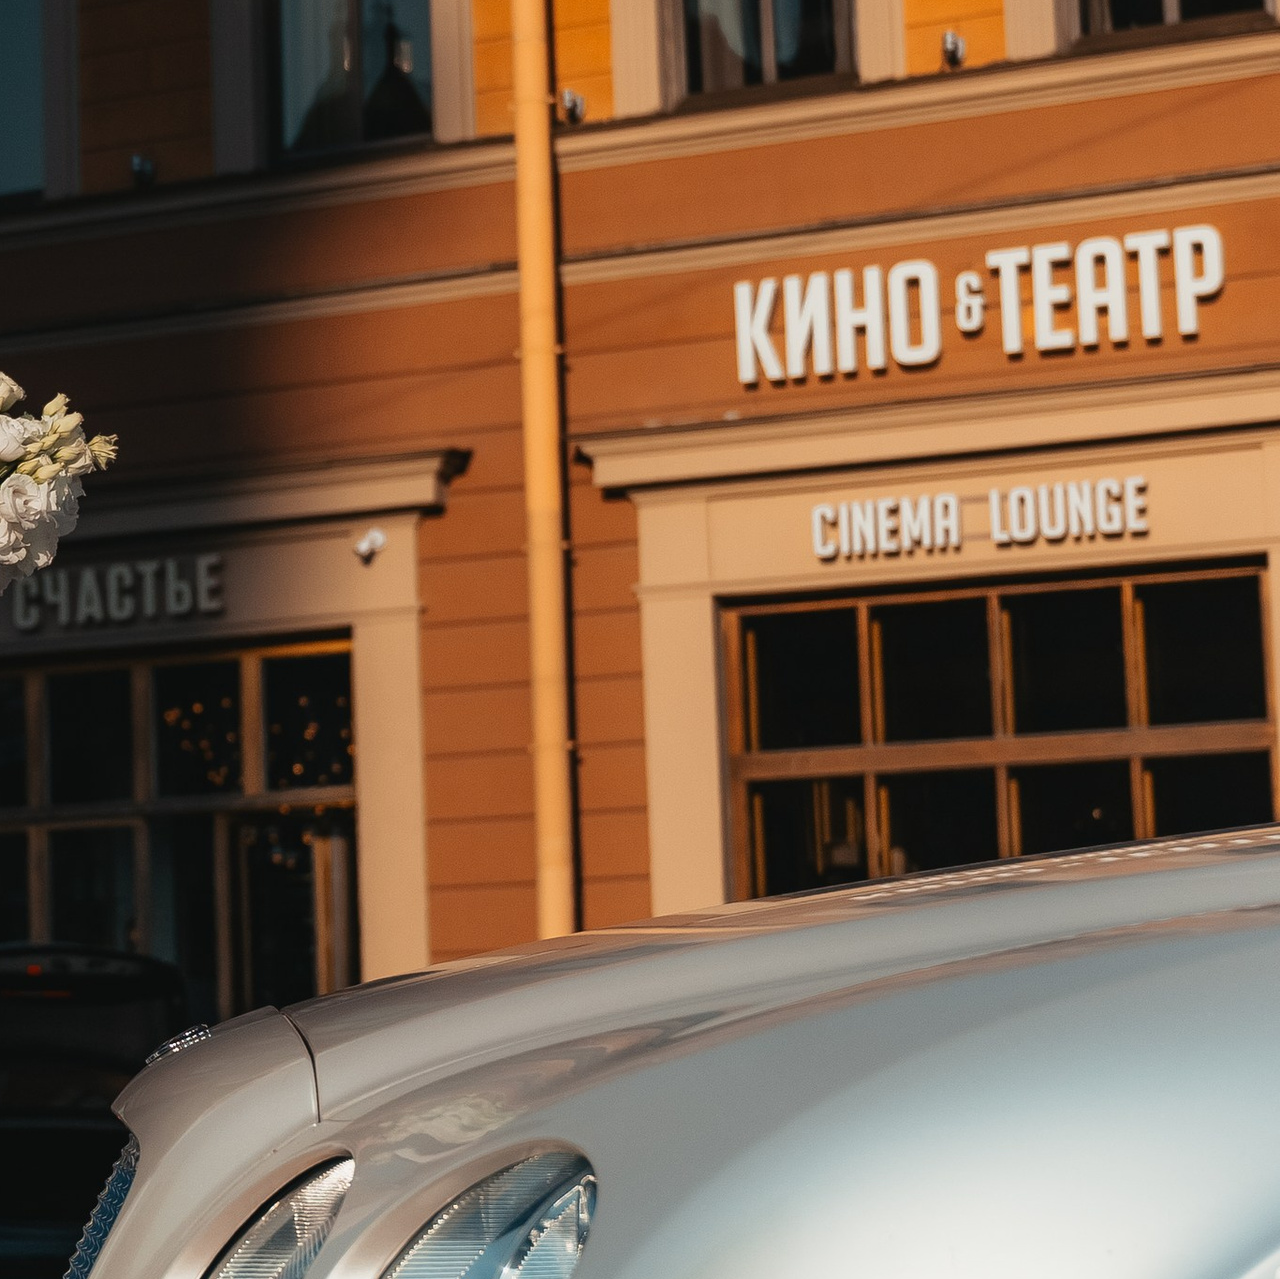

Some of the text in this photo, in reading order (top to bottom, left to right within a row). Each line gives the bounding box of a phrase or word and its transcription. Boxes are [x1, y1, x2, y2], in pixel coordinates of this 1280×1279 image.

[733, 224, 1225, 384] КИНО & ТЕАТР
[811, 475, 1148, 558] CINEMA LOUNGE
[12, 552, 222, 630] СЧАСТЬЕ
